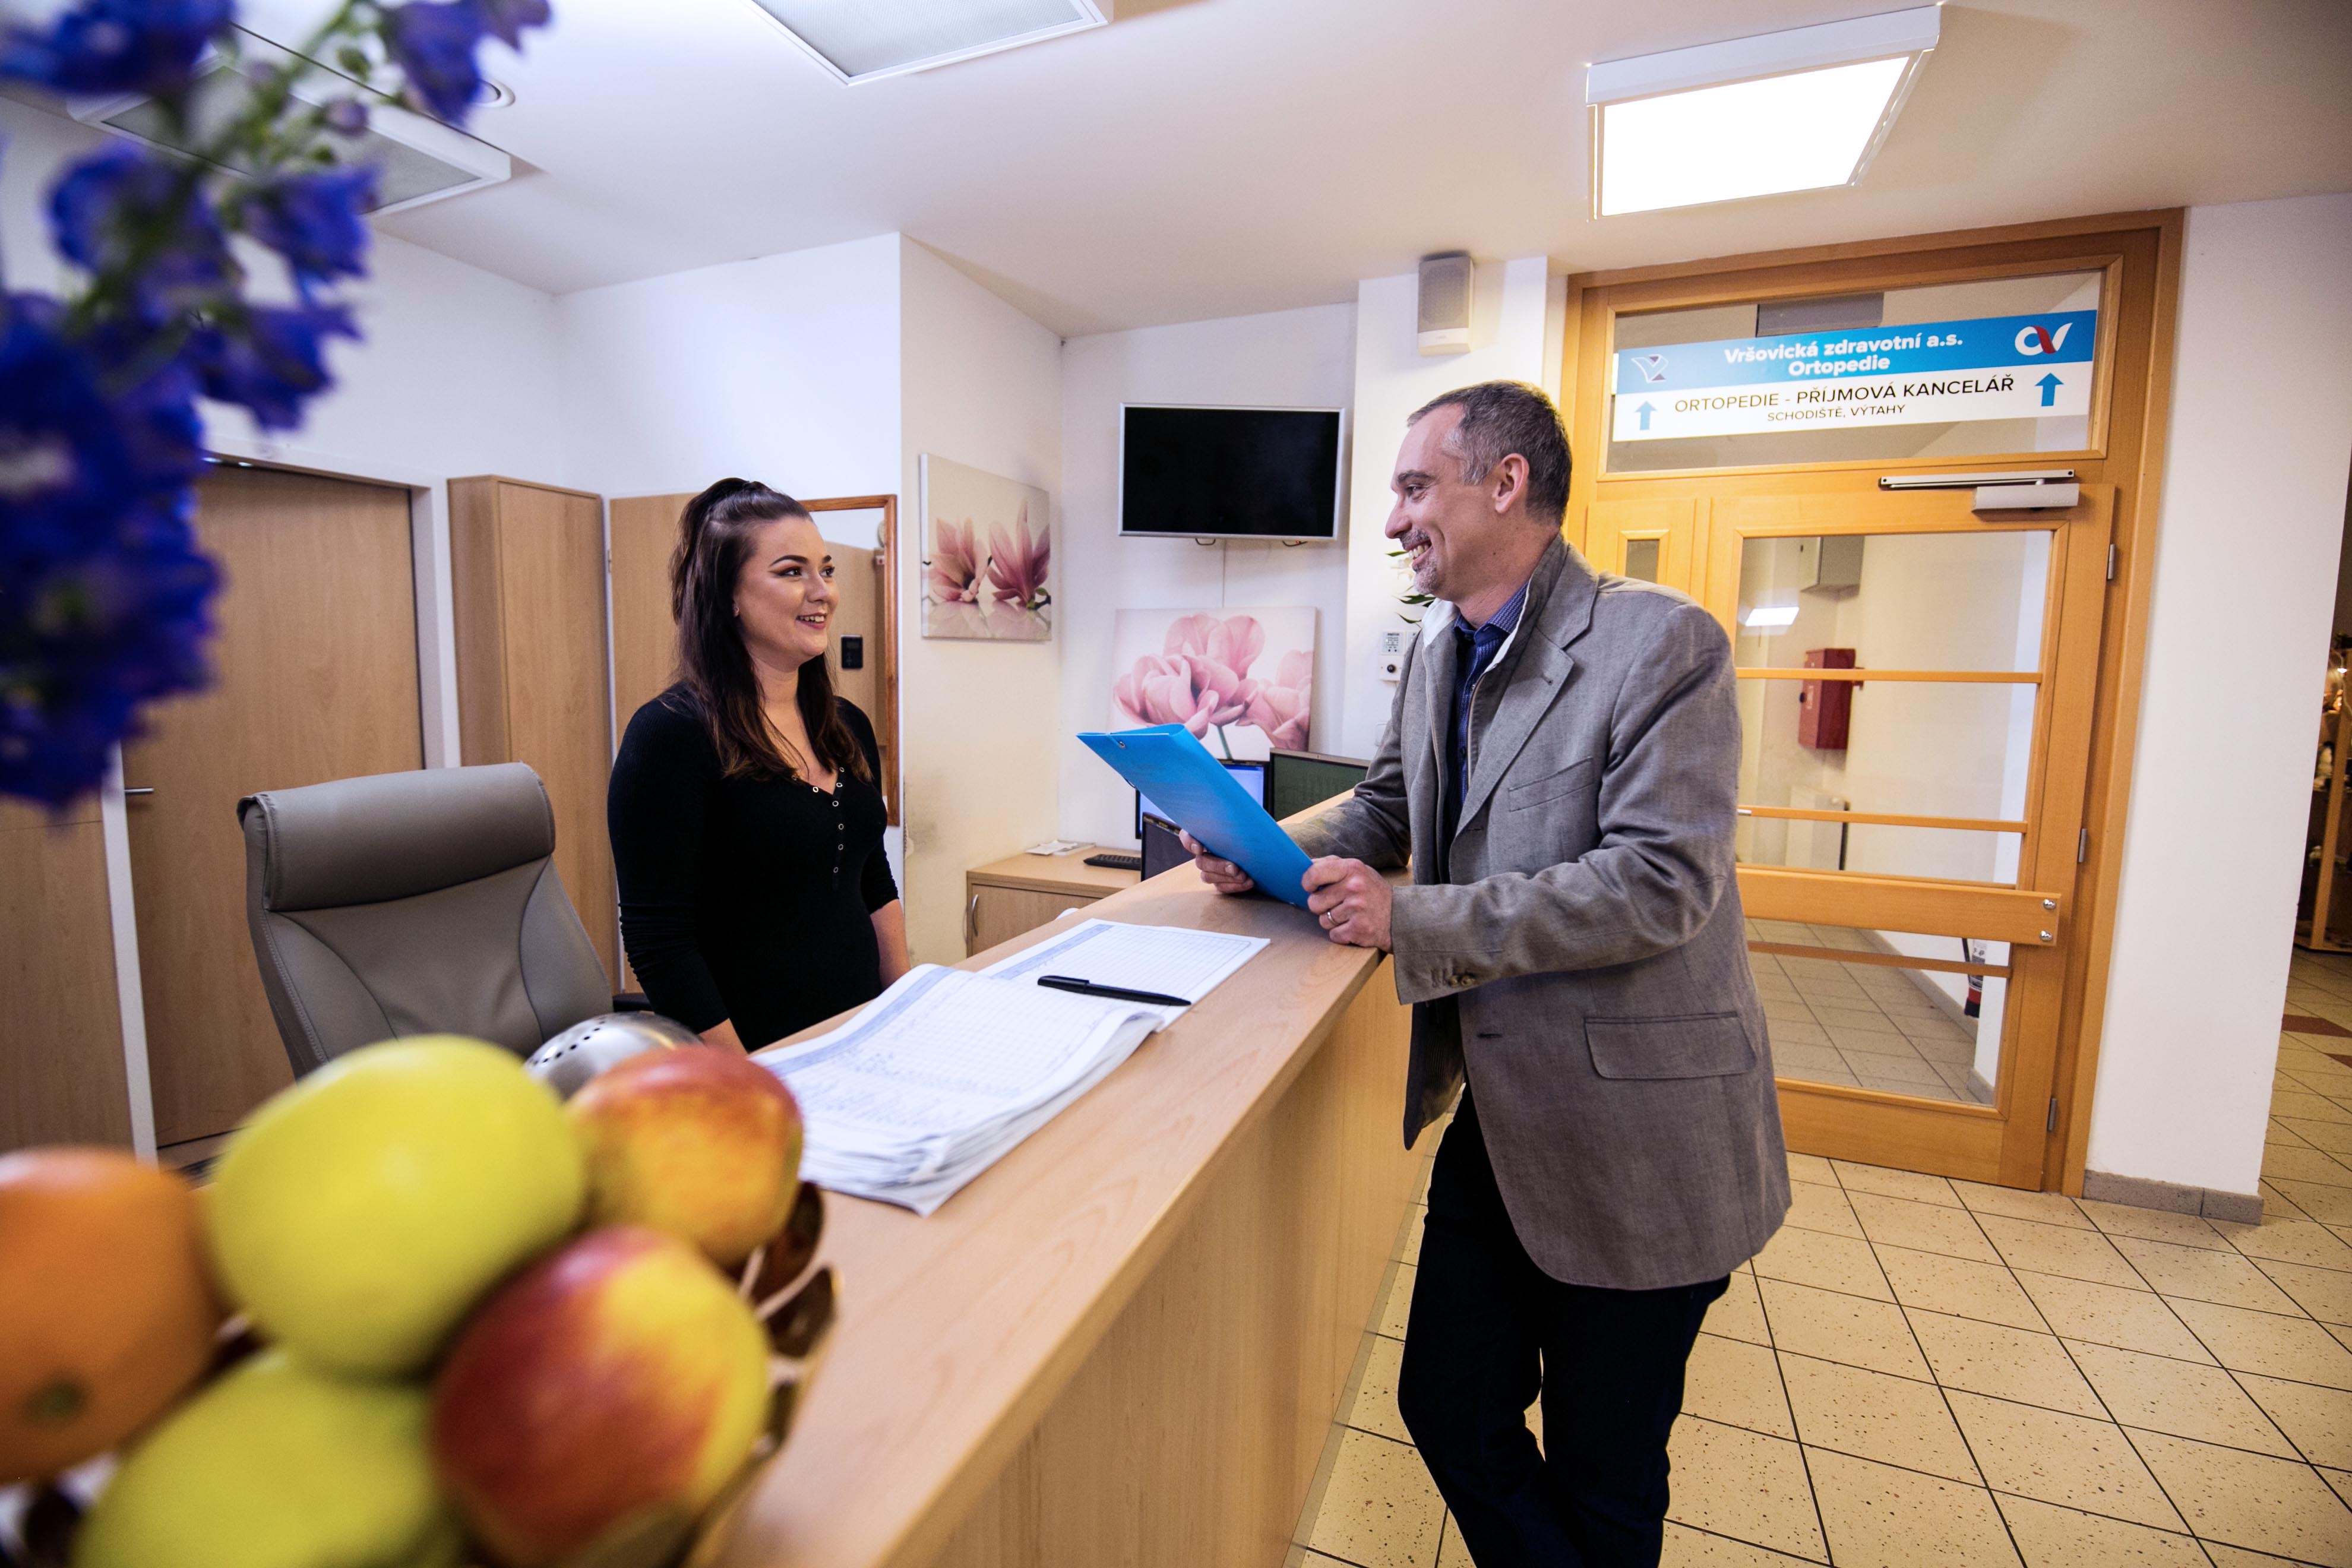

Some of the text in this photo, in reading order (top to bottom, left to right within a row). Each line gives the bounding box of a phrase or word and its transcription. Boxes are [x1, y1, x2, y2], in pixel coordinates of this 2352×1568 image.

[1724, 333, 1963, 364] Vršovická zdravotní a.s.
[1788, 354, 1891, 377] Ortopedie
[1674, 393, 1779, 413] ORTOPEDIE
[1796, 381, 1896, 404] PŘÍJMOVÁ
[1903, 373, 2015, 397] KANCELÁŘ
[1767, 404, 1906, 422] SCHODIŠTĚ, VÝTAHY
